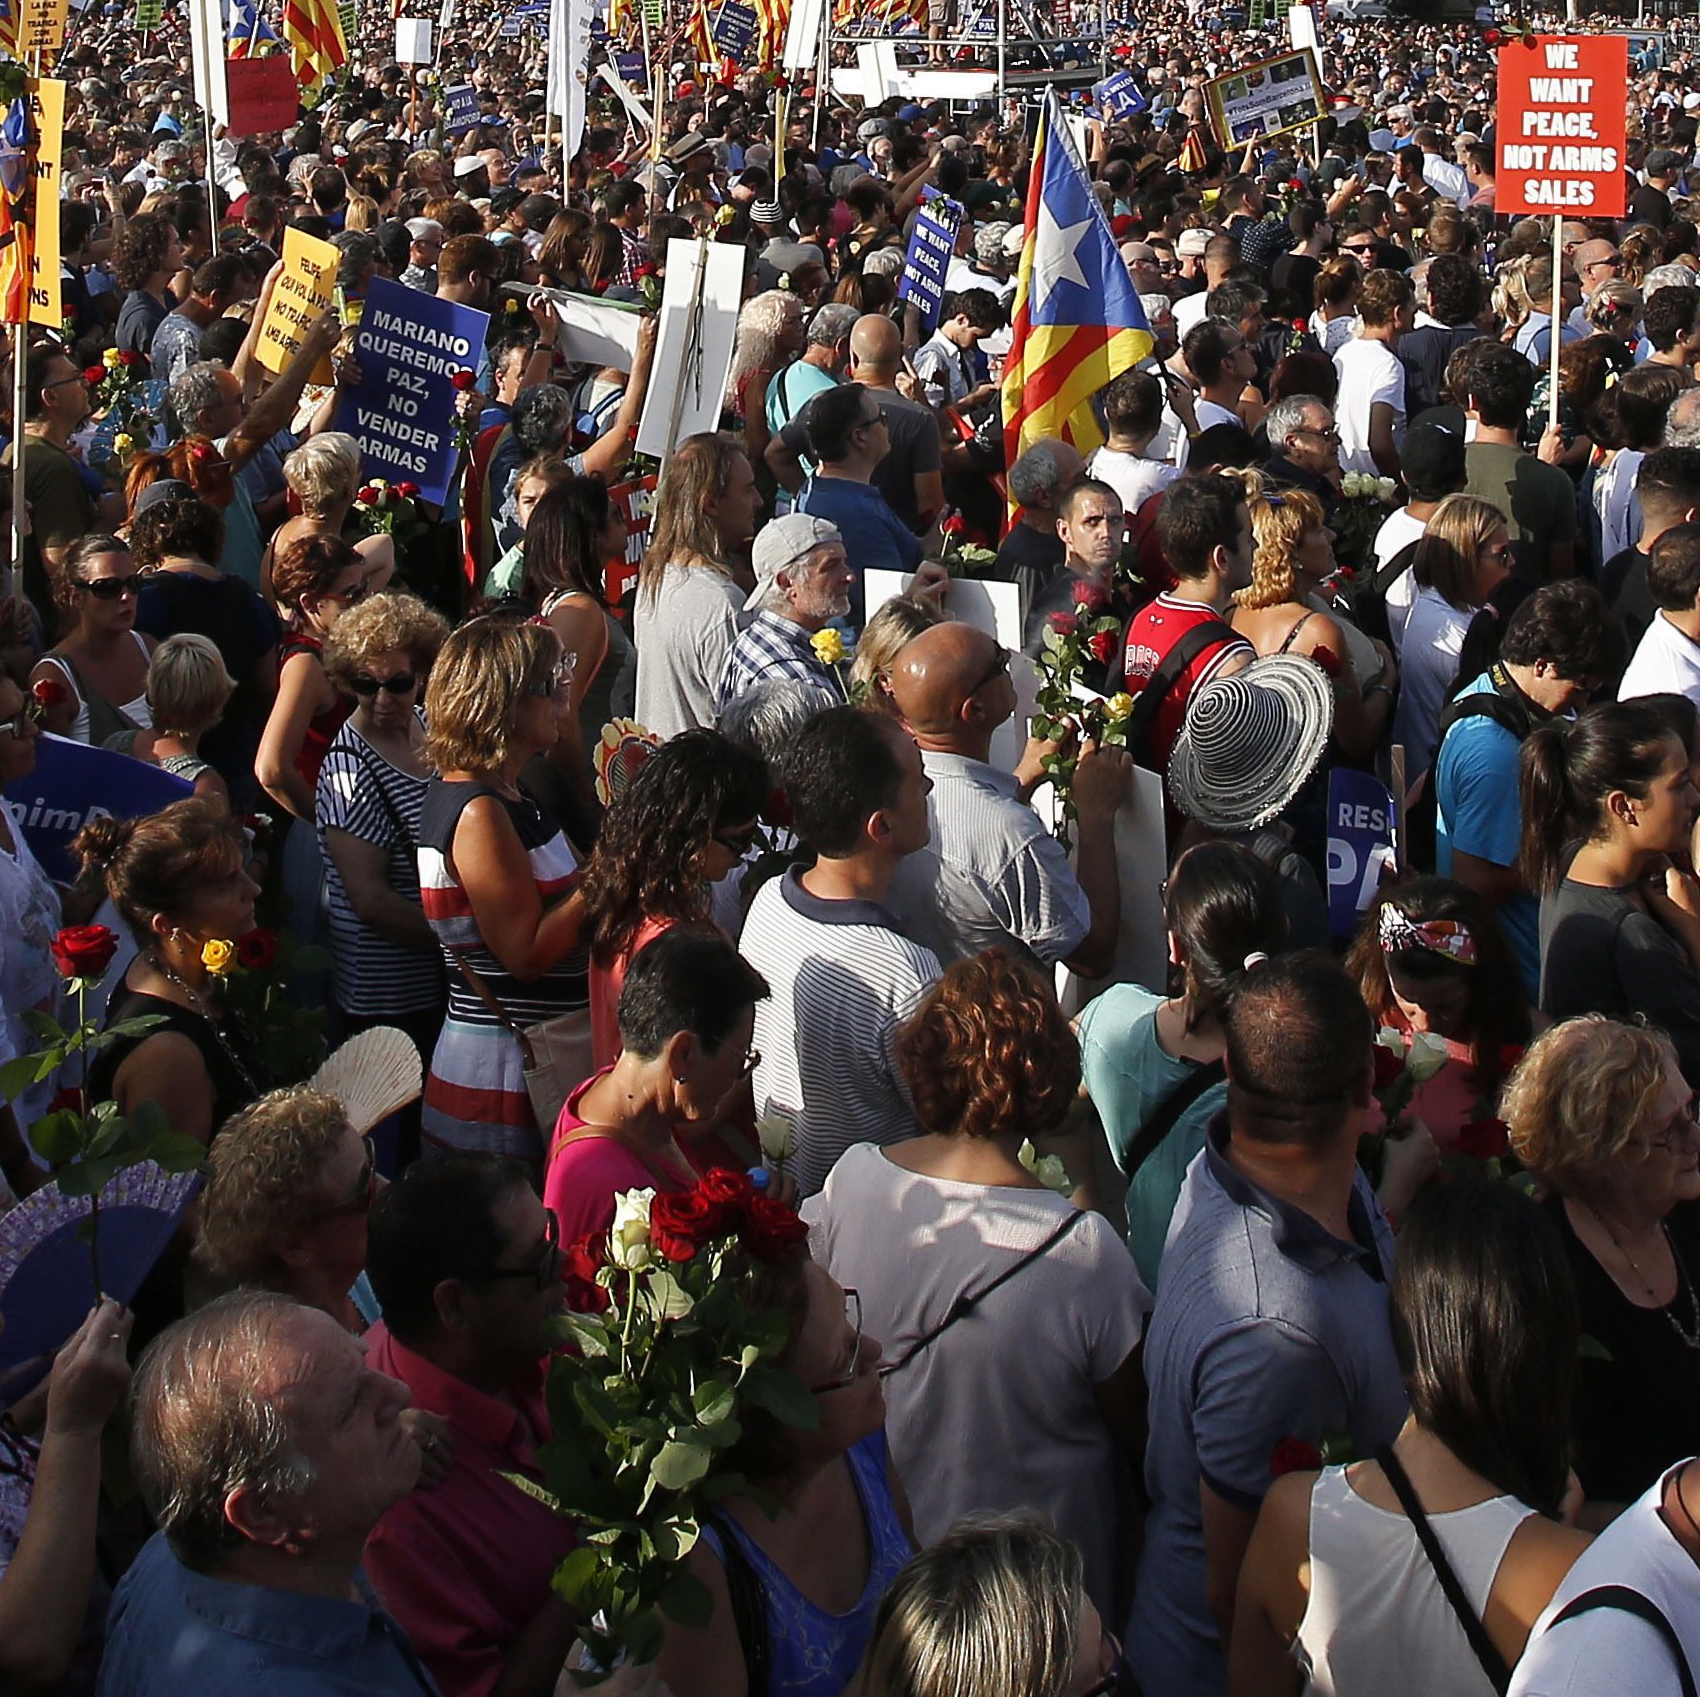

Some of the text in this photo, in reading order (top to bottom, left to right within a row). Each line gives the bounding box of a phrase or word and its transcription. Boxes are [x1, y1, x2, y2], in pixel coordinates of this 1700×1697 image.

[31, 2, 41, 10] LA
[28, 38, 53, 46] ARMAS
[34, 29, 50, 37] CON
[1544, 43, 1579, 70] WE
[1529, 77, 1594, 103] WANT
[1521, 111, 1599, 140] PEACE,
[1502, 144, 1617, 173] NOT ARMS
[1523, 178, 1595, 206] SALES
[914, 222, 951, 255] WE WANT
[913, 246, 941, 276] PEACE,
[280, 274, 295, 291] QUI
[294, 281, 307, 300] VOL
[904, 263, 943, 299] NOT ARMS
[272, 299, 313, 332] NO TRAFIC
[906, 288, 932, 315] SALES
[279, 334, 300, 354] ARME
[372, 310, 470, 356] MARIANO
[386, 367, 429, 400] PAZ,
[387, 393, 418, 417] NO
[356, 408, 440, 453] VENDER
[355, 435, 428, 474] ARMAS
